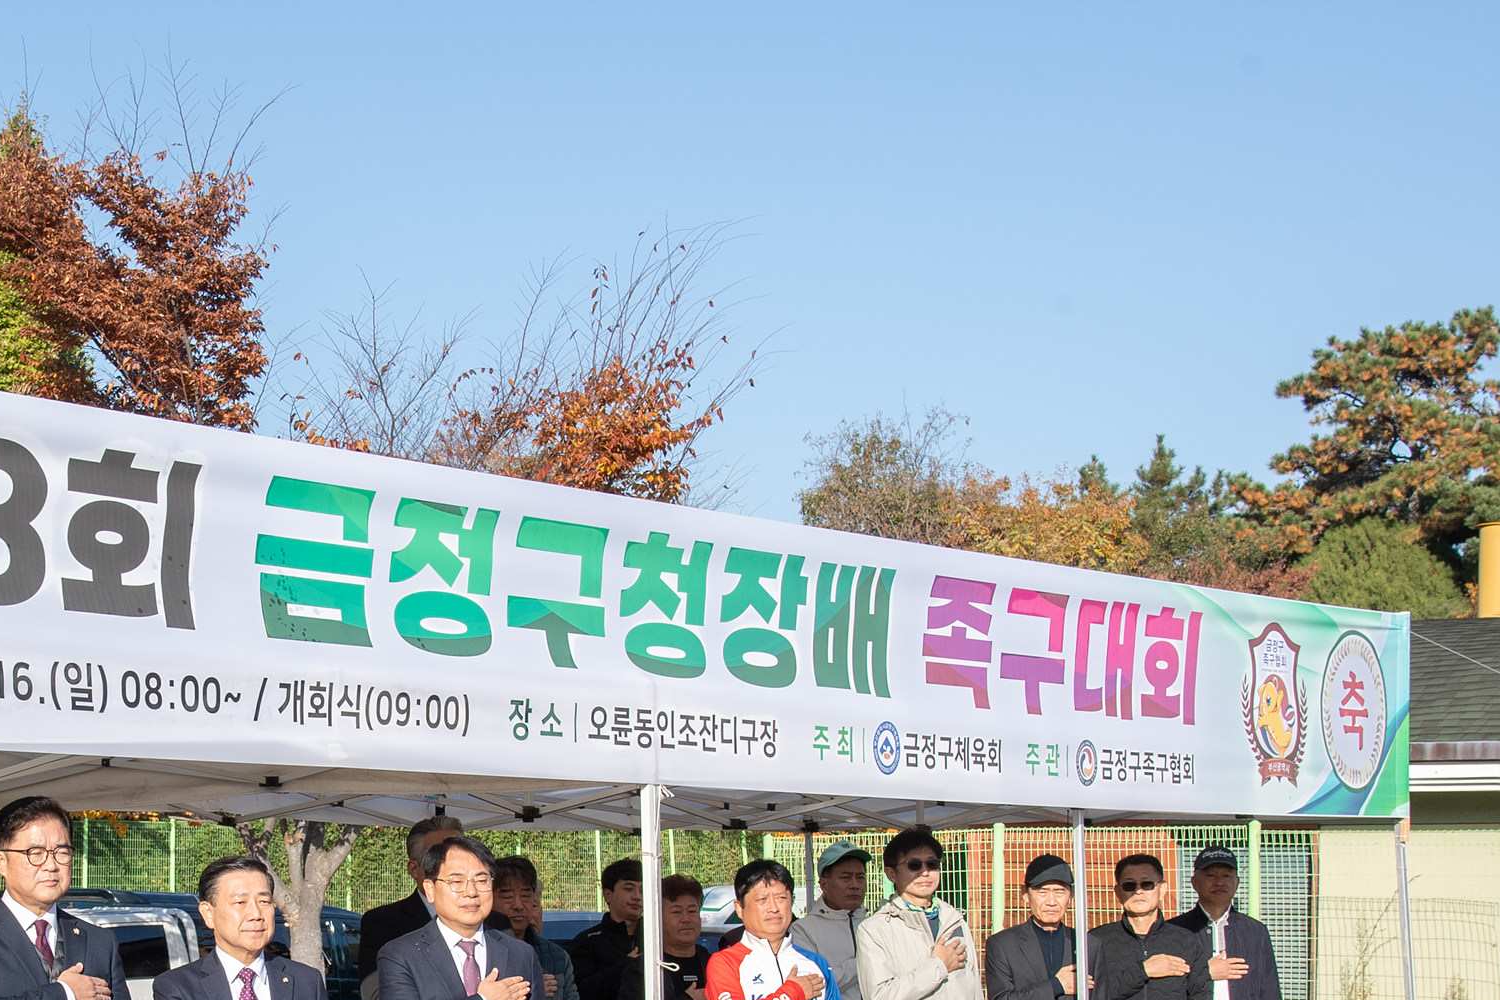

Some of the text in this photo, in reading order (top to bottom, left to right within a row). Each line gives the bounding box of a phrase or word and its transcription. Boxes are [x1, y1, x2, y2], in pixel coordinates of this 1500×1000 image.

[254, 474, 897, 698] 금정구청장배
[922, 575, 1204, 726] 족구대회
[277, 679, 470, 737] 개회식(09:00)
[587, 705, 779, 759] 오륜동인조잔디구장
[1338, 671, 1369, 752] 축
[903, 731, 1003, 774] 금정구체육회
[1100, 748, 1196, 785] 금정구족구협회
